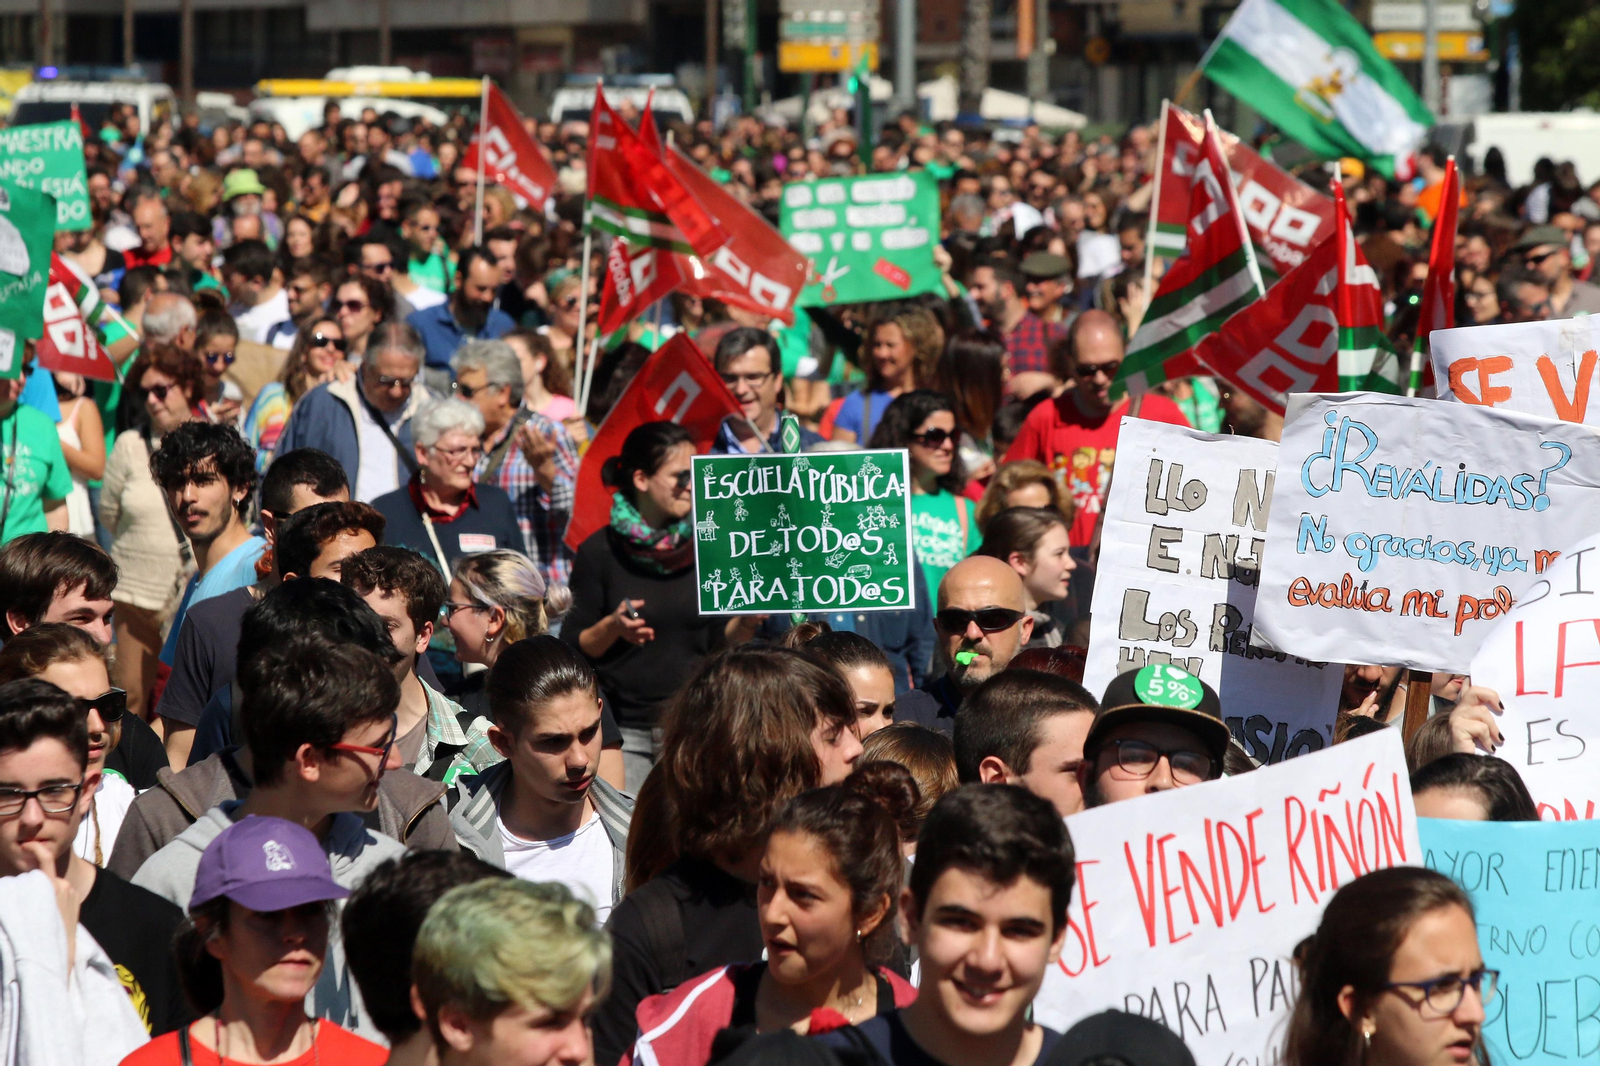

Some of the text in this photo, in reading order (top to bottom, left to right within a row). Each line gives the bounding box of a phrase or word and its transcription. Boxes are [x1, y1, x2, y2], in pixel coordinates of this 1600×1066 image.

[703, 465, 906, 504] ESCUELA PÚBLICA:
[729, 526, 884, 558] DE TOD@S
[1296, 511, 1336, 555] No
[711, 574, 905, 609] PARA TOD@S
[1286, 572, 1394, 613] evalúa
[1399, 588, 1450, 618] mi
[1118, 587, 1199, 648] LOS
[1526, 717, 1587, 766] ES
[1123, 806, 1277, 948] VENDE
[1284, 761, 1407, 906] RIÑÓN
[1544, 847, 1600, 893] ENE
[1123, 973, 1227, 1042] PARA
